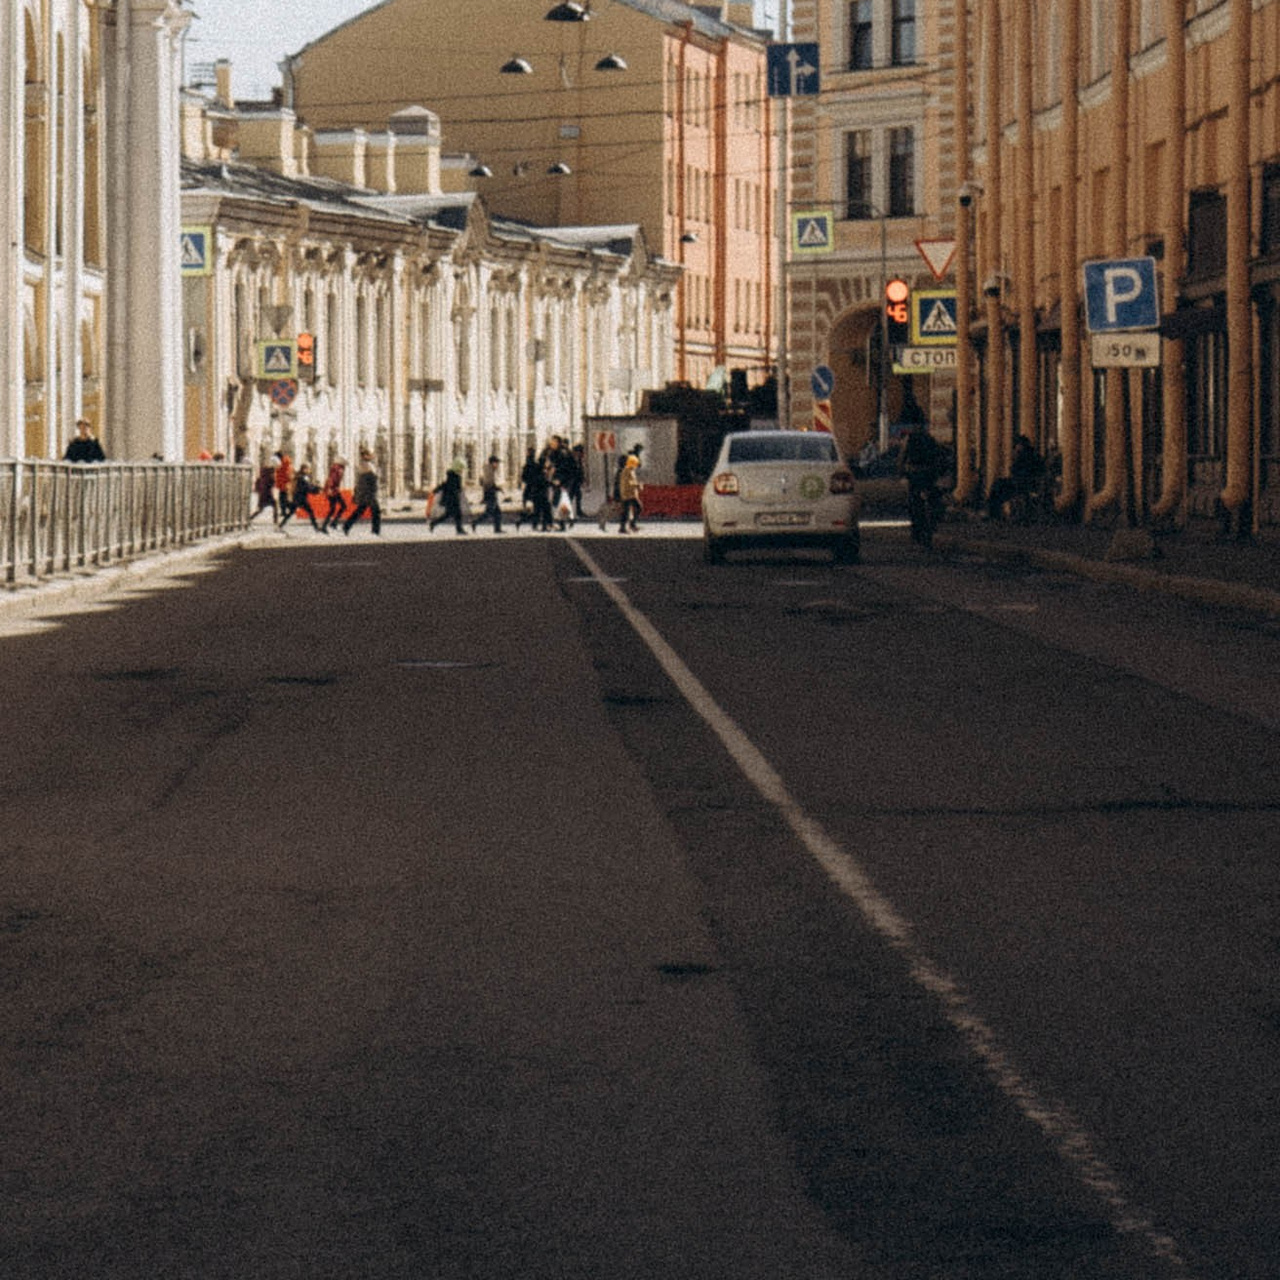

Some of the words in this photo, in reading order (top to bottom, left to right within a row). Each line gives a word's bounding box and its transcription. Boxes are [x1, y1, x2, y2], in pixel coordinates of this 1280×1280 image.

[1104, 268, 1142, 323] P
[886, 304, 907, 323] 46
[910, 350, 956, 365] СТОП
